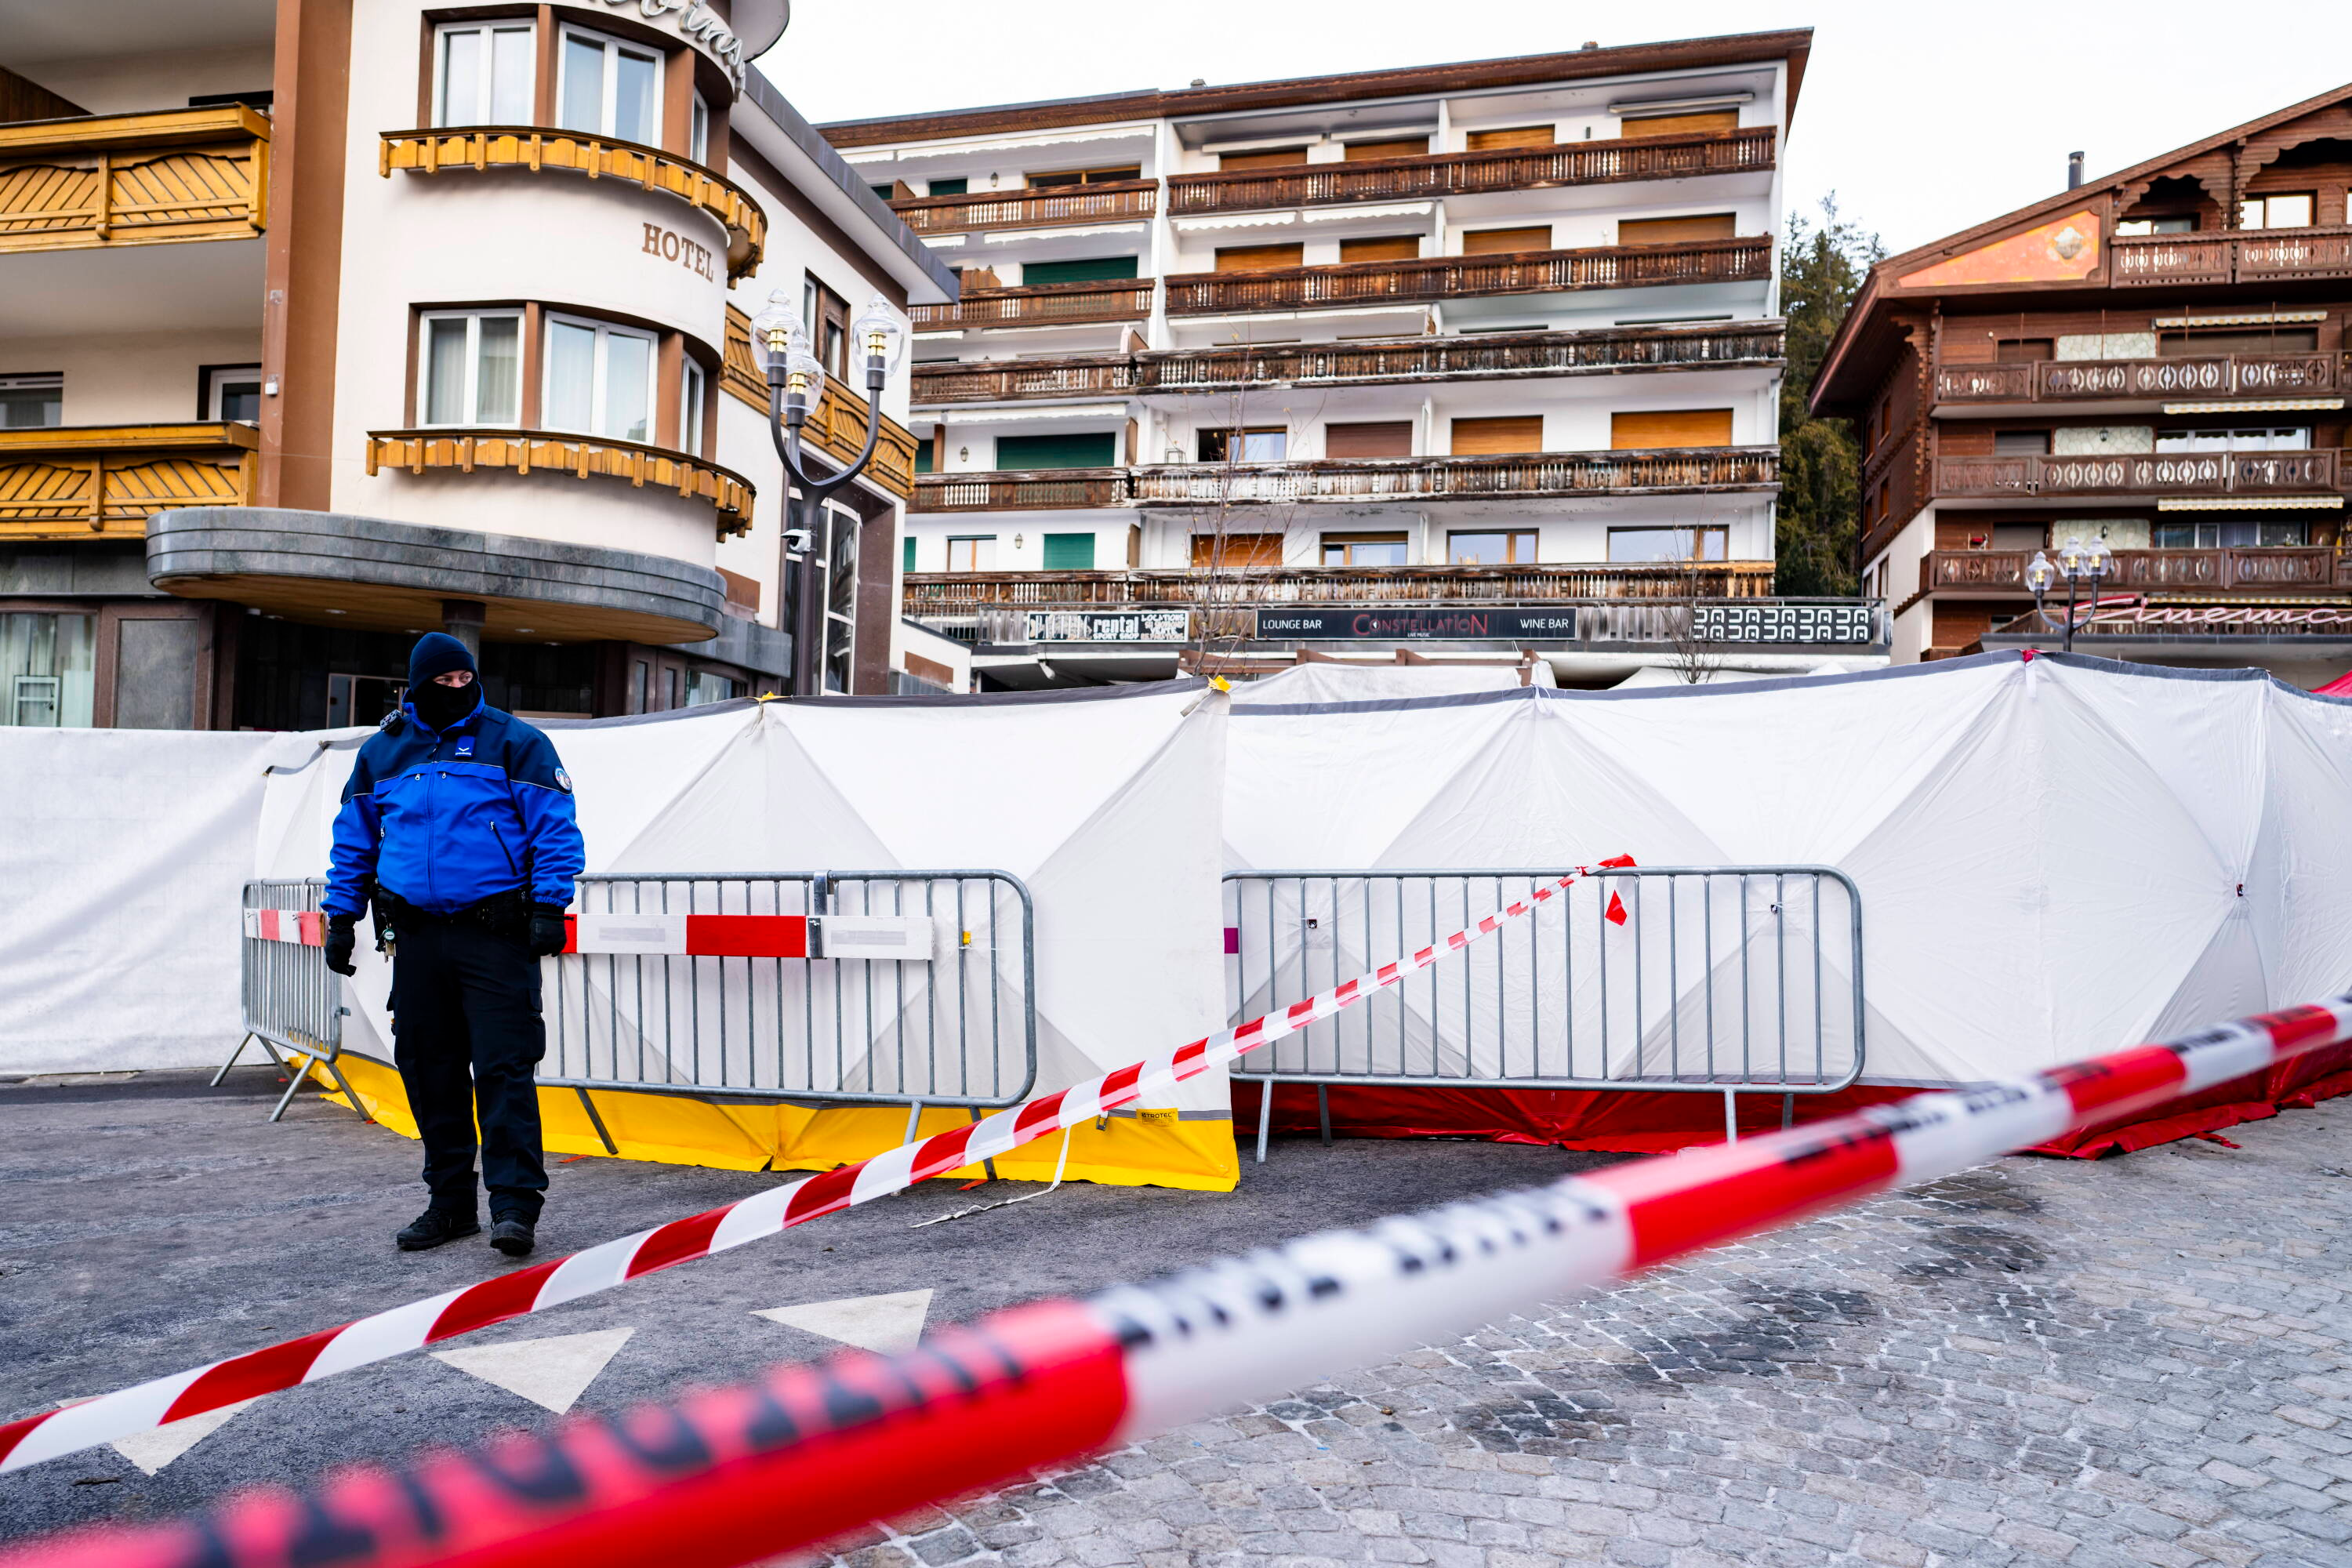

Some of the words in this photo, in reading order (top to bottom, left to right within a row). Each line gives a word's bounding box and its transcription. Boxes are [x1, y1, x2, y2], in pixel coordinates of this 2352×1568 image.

[641, 222, 714, 283] HOTEL
[2063, 593, 2352, 625] Cinema
[1093, 616, 1139, 633] rental
[1262, 619, 1301, 629] LOUNGE
[1302, 619, 1322, 630] BAR
[1519, 618, 1547, 629] WINE
[1548, 618, 1569, 629] BAR
